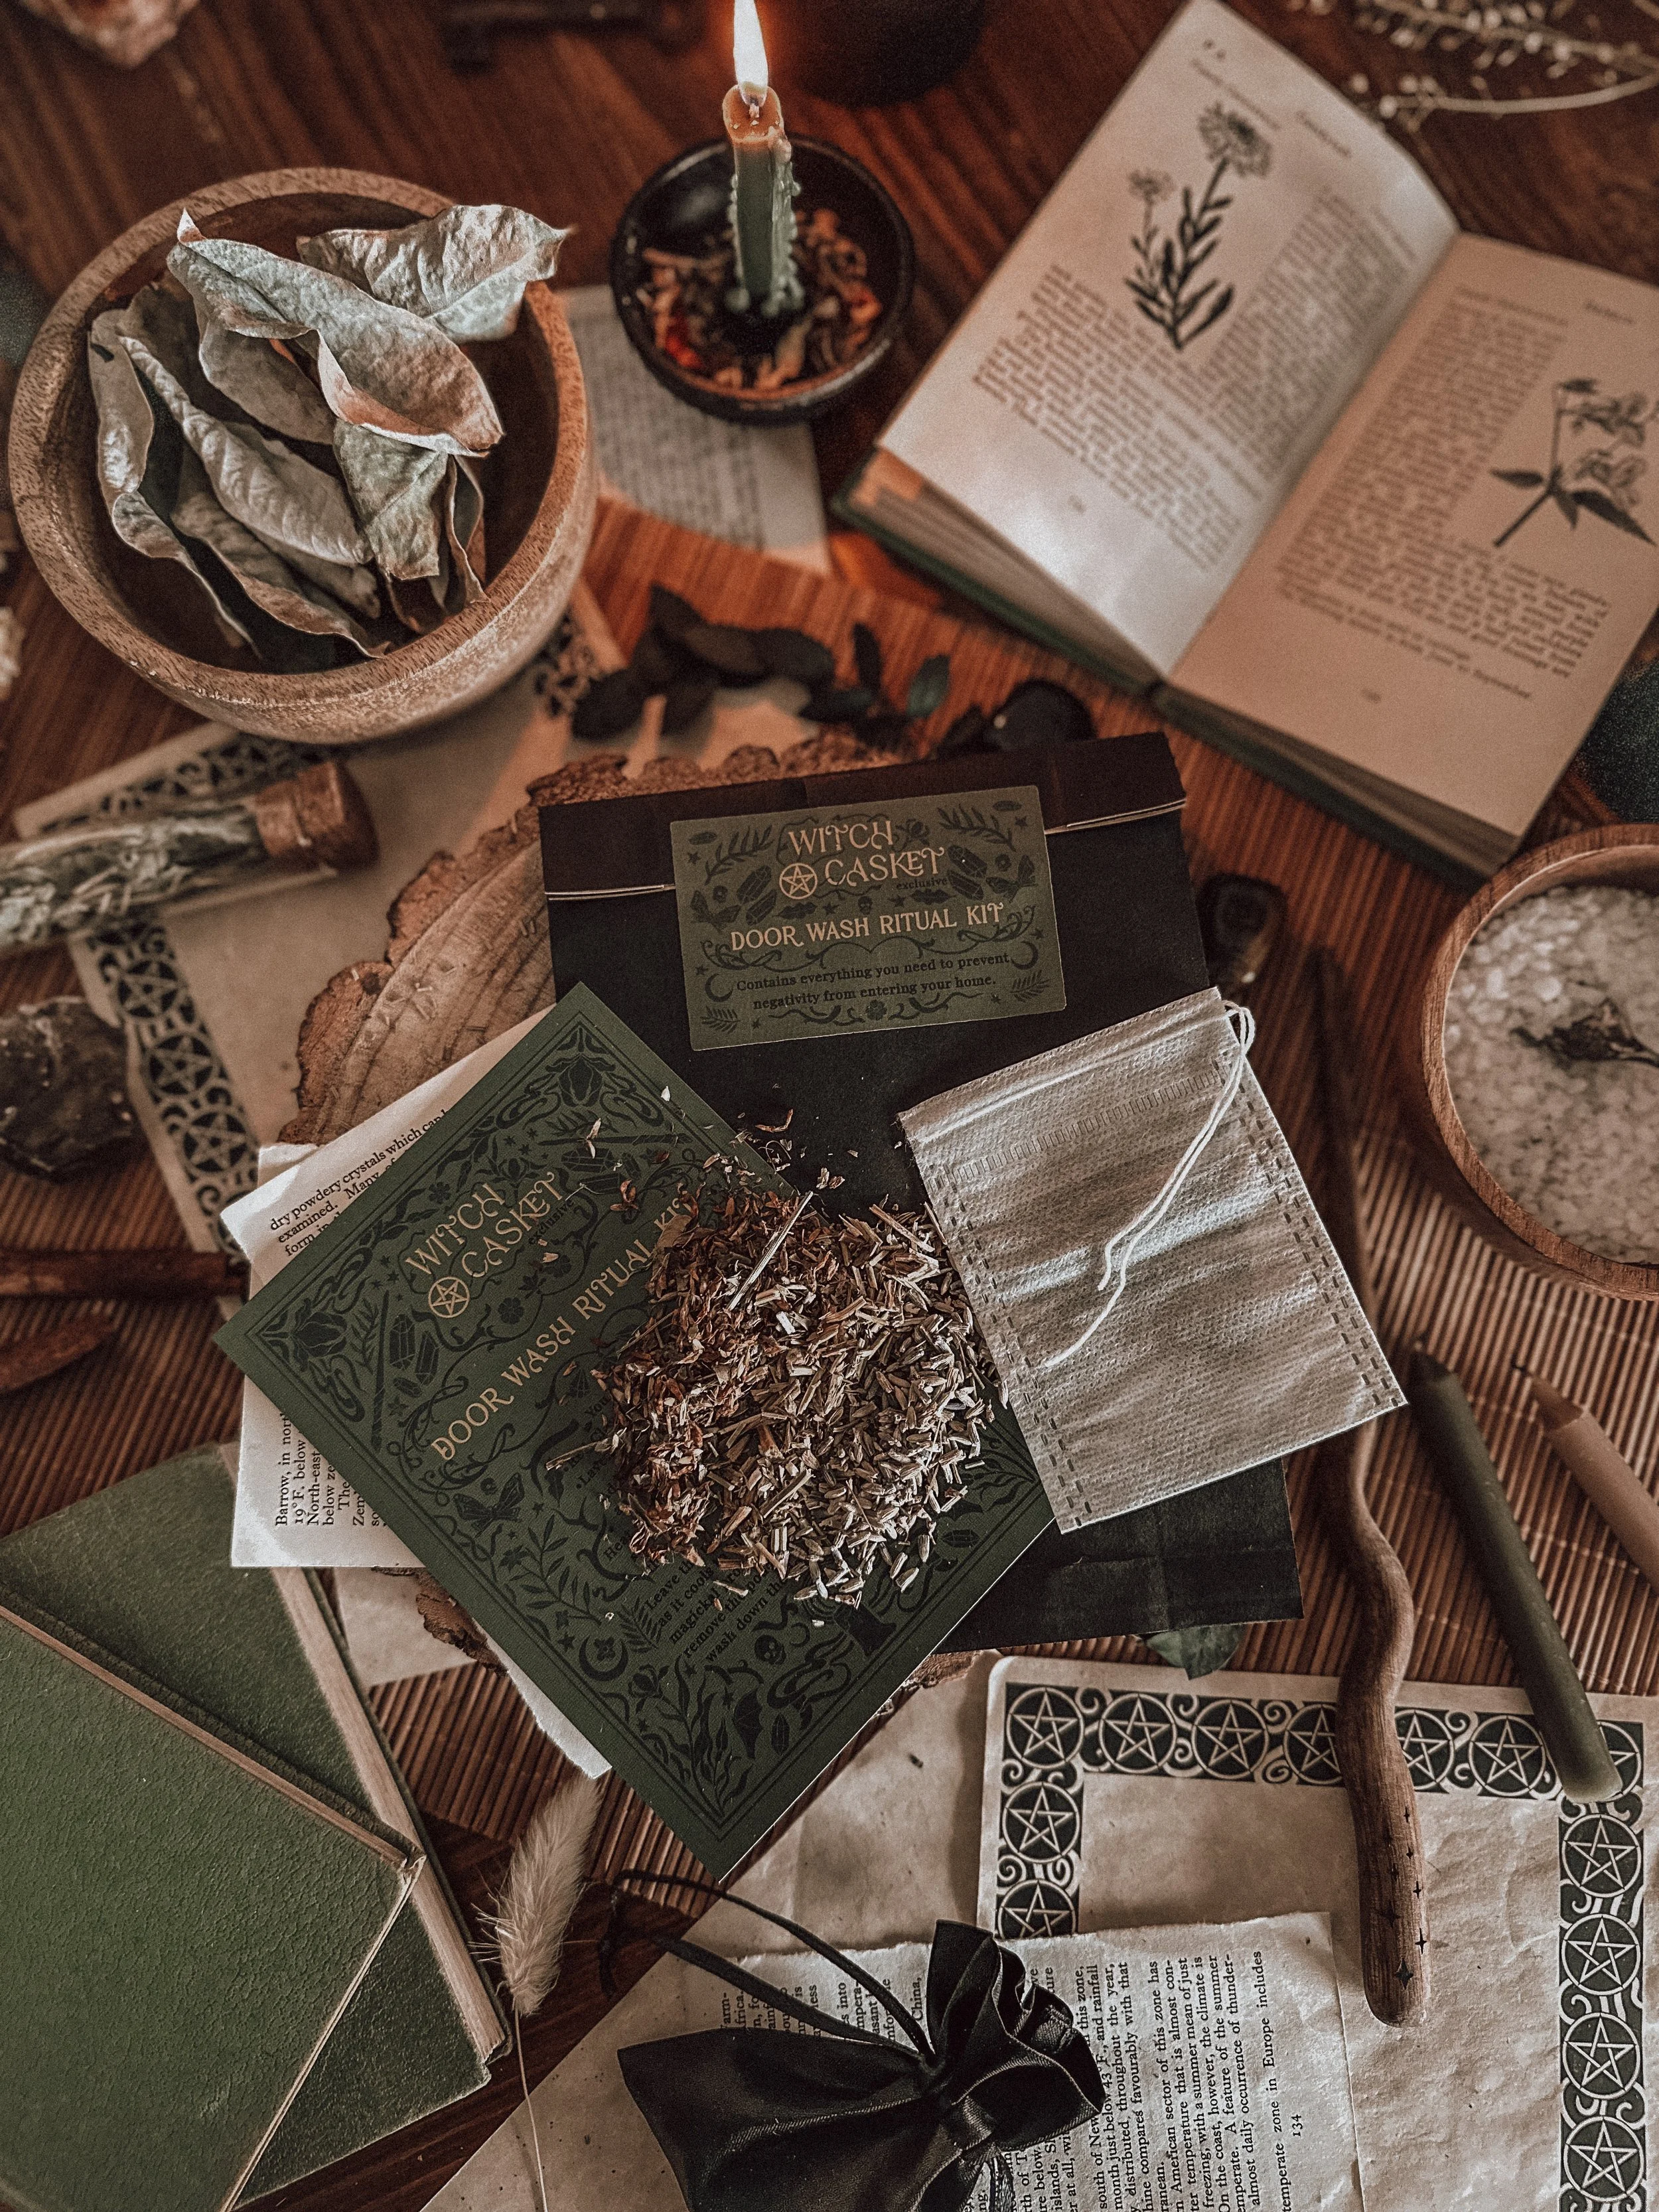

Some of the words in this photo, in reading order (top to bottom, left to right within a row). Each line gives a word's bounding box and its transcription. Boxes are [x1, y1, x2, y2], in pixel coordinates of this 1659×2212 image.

[787, 820, 893, 855] WITCH
[824, 846, 944, 887] CASKET
[895, 877, 947, 890] exclusive
[730, 925, 804, 950] DOOR
[805, 917, 869, 942] WASH
[879, 908, 957, 934] RITUAL
[966, 901, 1004, 925] KIT
[736, 975, 796, 992] Contains
[800, 967, 872, 984] everything
[875, 966, 899, 978] you
[904, 958, 936, 973] need
[939, 958, 954, 969] to
[957, 952, 1009, 970] prevent
[753, 992, 820, 1009] negativity
[823, 990, 856, 1001] from
[859, 982, 916, 997] entering
[920, 980, 952, 994] your
[954, 976, 996, 988] home.
[270, 1213, 290, 1230] dry
[291, 1179, 341, 1220] powdery
[342, 1151, 386, 1183] crystals
[384, 1128, 423, 1154] which
[278, 1199, 338, 1243] examined.
[342, 1171, 379, 1199] Many
[461, 1171, 563, 1278] CASKET
[285, 1233, 315, 1256] form
[404, 1183, 505, 1274] WITCH
[430, 1387, 514, 1460] DOOR
[500, 1315, 576, 1386] WASH
[571, 1238, 654, 1320] RITUAL
[277, 1451, 290, 1465] in
[292, 1439, 306, 1480] below
[274, 1471, 291, 1526] Barrow,
[306, 1451, 321, 1525] North-east
[321, 1484, 334, 1526] below
[337, 1481, 350, 1511] The
[643, 1574, 680, 1611] Leave
[658, 1610, 672, 1627] as
[669, 1598, 684, 1613] it
[684, 1570, 713, 1599] cools
[668, 1587, 721, 1645] magickal
[705, 1631, 737, 1662] wash
[736, 1596, 768, 1631] down
[682, 1612, 726, 1659] remove
[1104, 1963, 1118, 1997] year,
[1117, 1961, 1129, 1990] that
[1147, 1960, 1159, 1984] has
[1165, 1959, 1175, 1990] con-
[1177, 1957, 1192, 1984] just
[1194, 1956, 1203, 1968] is
[1252, 1951, 1267, 2008] includes
[837, 1982, 849, 2008] into
[910, 1976, 924, 2022] China,
[1074, 1965, 1086, 2003] zone,
[1086, 1964, 1103, 2012] rainfall
[1178, 1985, 1191, 2000] of
[1195, 1972, 1208, 2021] climate
[1208, 1954, 1222, 2010] summer
[1222, 1954, 1238, 2014] thunder-
[735, 1990, 747, 2026] frica.
[853, 1981, 866, 2029] mpera-
[868, 2000, 880, 2033] asant
[1076, 2005, 1089, 2030] this
[1106, 2004, 1118, 2026] the
[1119, 1994, 1133, 2026] with
[1152, 1989, 1163, 2021] zone
[1167, 1996, 1181, 2041] almost
[1184, 2003, 1196, 2039] mean
[1091, 2016, 1105, 2041] and
[1153, 2026, 1167, 2051] this
[1198, 2026, 1212, 2048] the
[1212, 2017, 1226, 2039] the
[1227, 2020, 1240, 2034] of
[1261, 2018, 1275, 2068] Europe
[1123, 2032, 1142, 2104] favourably
[1155, 2057, 1169, 2073] of
[1170, 2047, 1183, 2060] is
[1188, 2043, 1202, 2099] summer
[1214, 2044, 1228, 2061] of
[1110, 2034, 1127, 2112] throughout
[1173, 2065, 1187, 2095] that
[1204, 2053, 1220, 2115] however,
[1220, 2067, 1234, 2115] feature
[1233, 2039, 1249, 2114] occurrence
[1265, 2077, 1277, 2091] in
[1161, 2079, 1174, 2120] sector
[1271, 2101, 1282, 2132] zone
[1131, 2109, 1149, 2175] compares
[1179, 2101, 1196, 2185] temperature
[1192, 2112, 1206, 2144] with
[1210, 2120, 1224, 2160] coast,
[1224, 2121, 1237, 2134] A
[1239, 2119, 1254, 2153] daily
[1290, 2114, 1303, 2136] 134
[1090, 2151, 1103, 2166] of
[1106, 2134, 1121, 2162] just
[1165, 2126, 1183, 2193] American
[1016, 2171, 1030, 2187] of
[1047, 2158, 1062, 2211] islands,
[1062, 2157, 1075, 2178] all,
[1198, 2147, 1214, 2208] freezing,
[1214, 2164, 1228, 2187] the
[1246, 2158, 1260, 2205] almost
[1275, 2142, 1291, 2212] temperate
[1066, 2182, 1076, 2197] at
[1092, 2170, 1108, 2209] south
[1107, 2163, 1123, 2210] month
[1218, 2192, 1230, 2212] On
